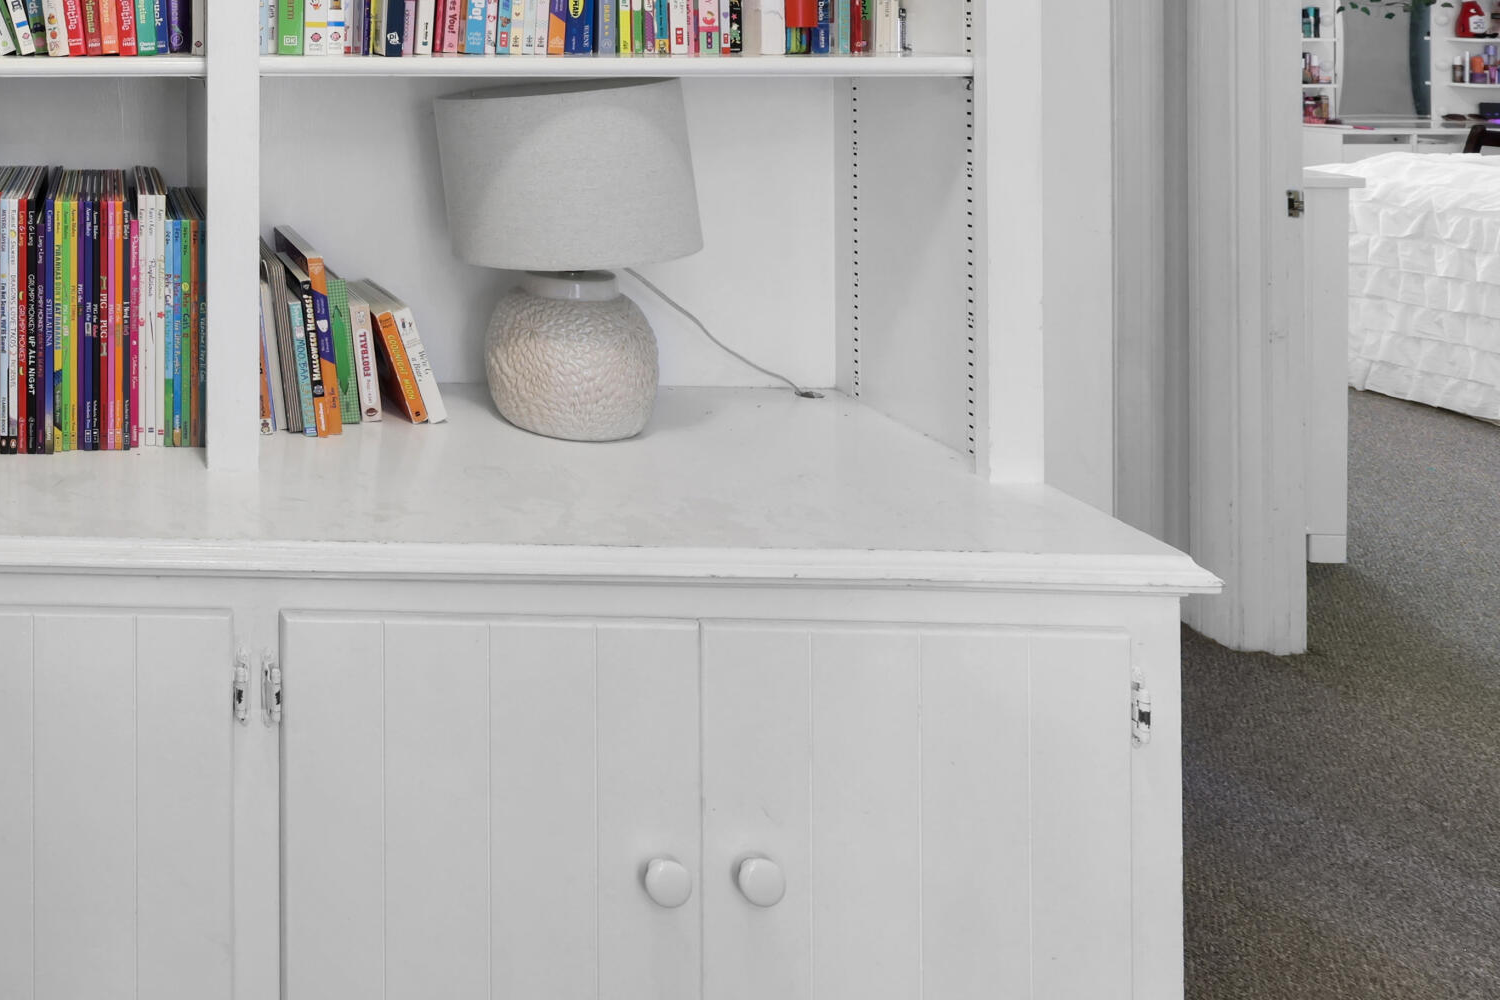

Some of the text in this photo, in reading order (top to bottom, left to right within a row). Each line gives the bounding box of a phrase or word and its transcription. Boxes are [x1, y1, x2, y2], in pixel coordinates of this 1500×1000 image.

[447, 13, 457, 34] You!
[303, 294, 321, 381] HALLOWEEN HEROES!
[359, 332, 371, 377] FOOTBALL
